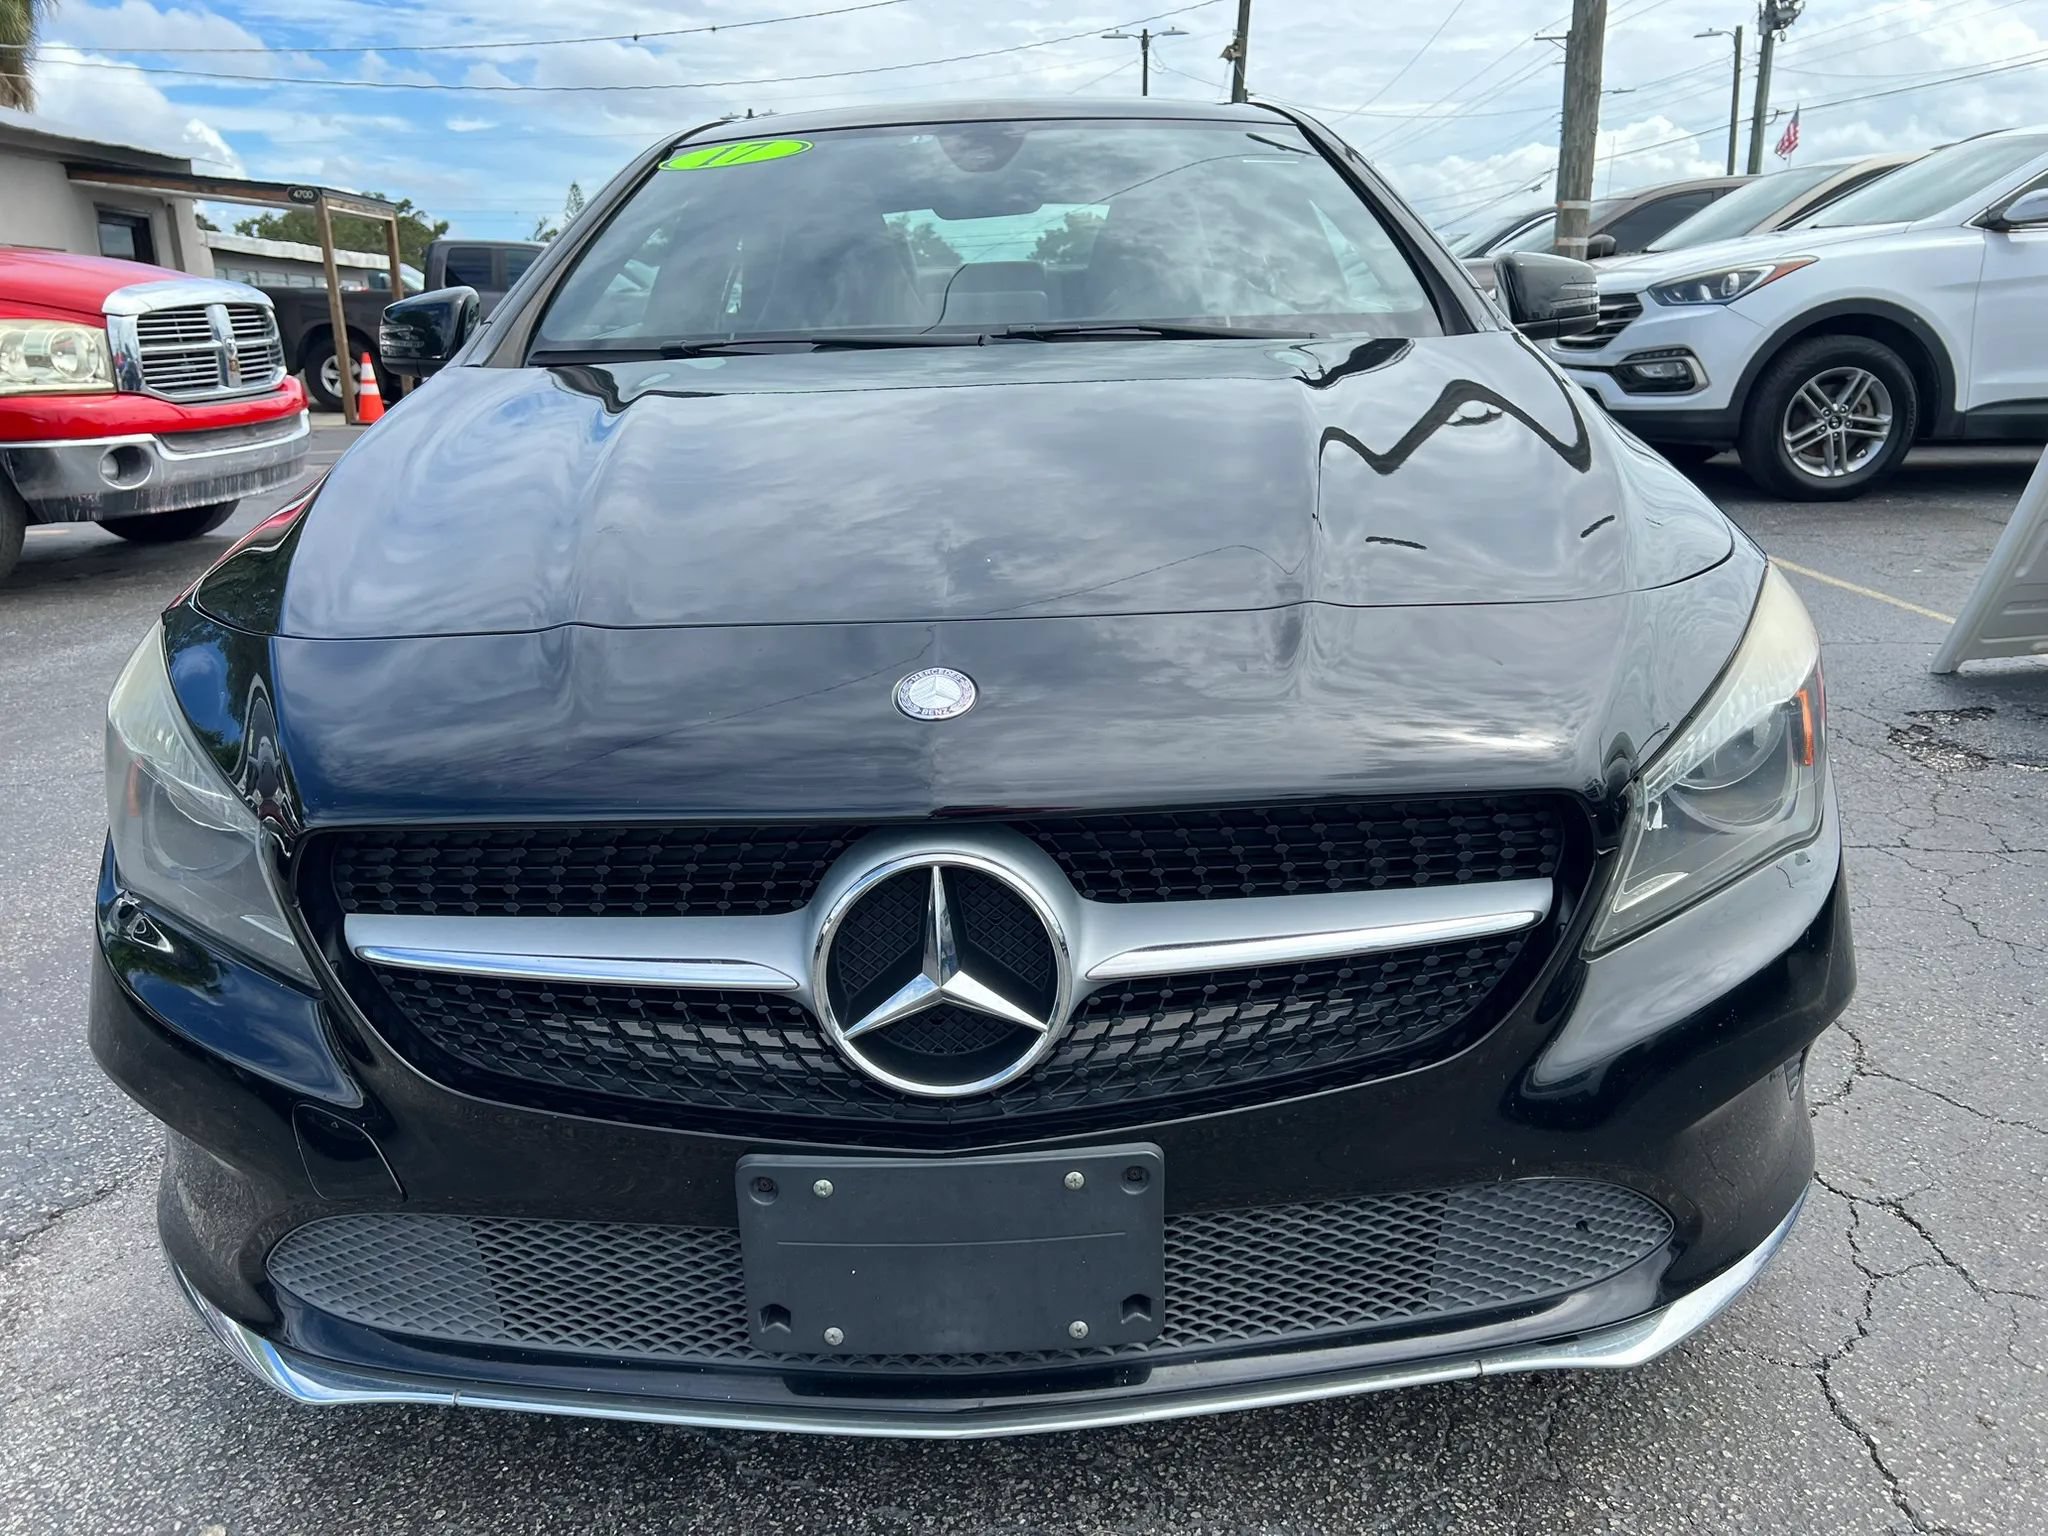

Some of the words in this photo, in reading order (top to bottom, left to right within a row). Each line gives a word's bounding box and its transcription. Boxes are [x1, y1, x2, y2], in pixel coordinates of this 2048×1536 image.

[695, 141, 776, 167] 17
[293, 189, 314, 199] 4700
[921, 708, 951, 716] BENZ
